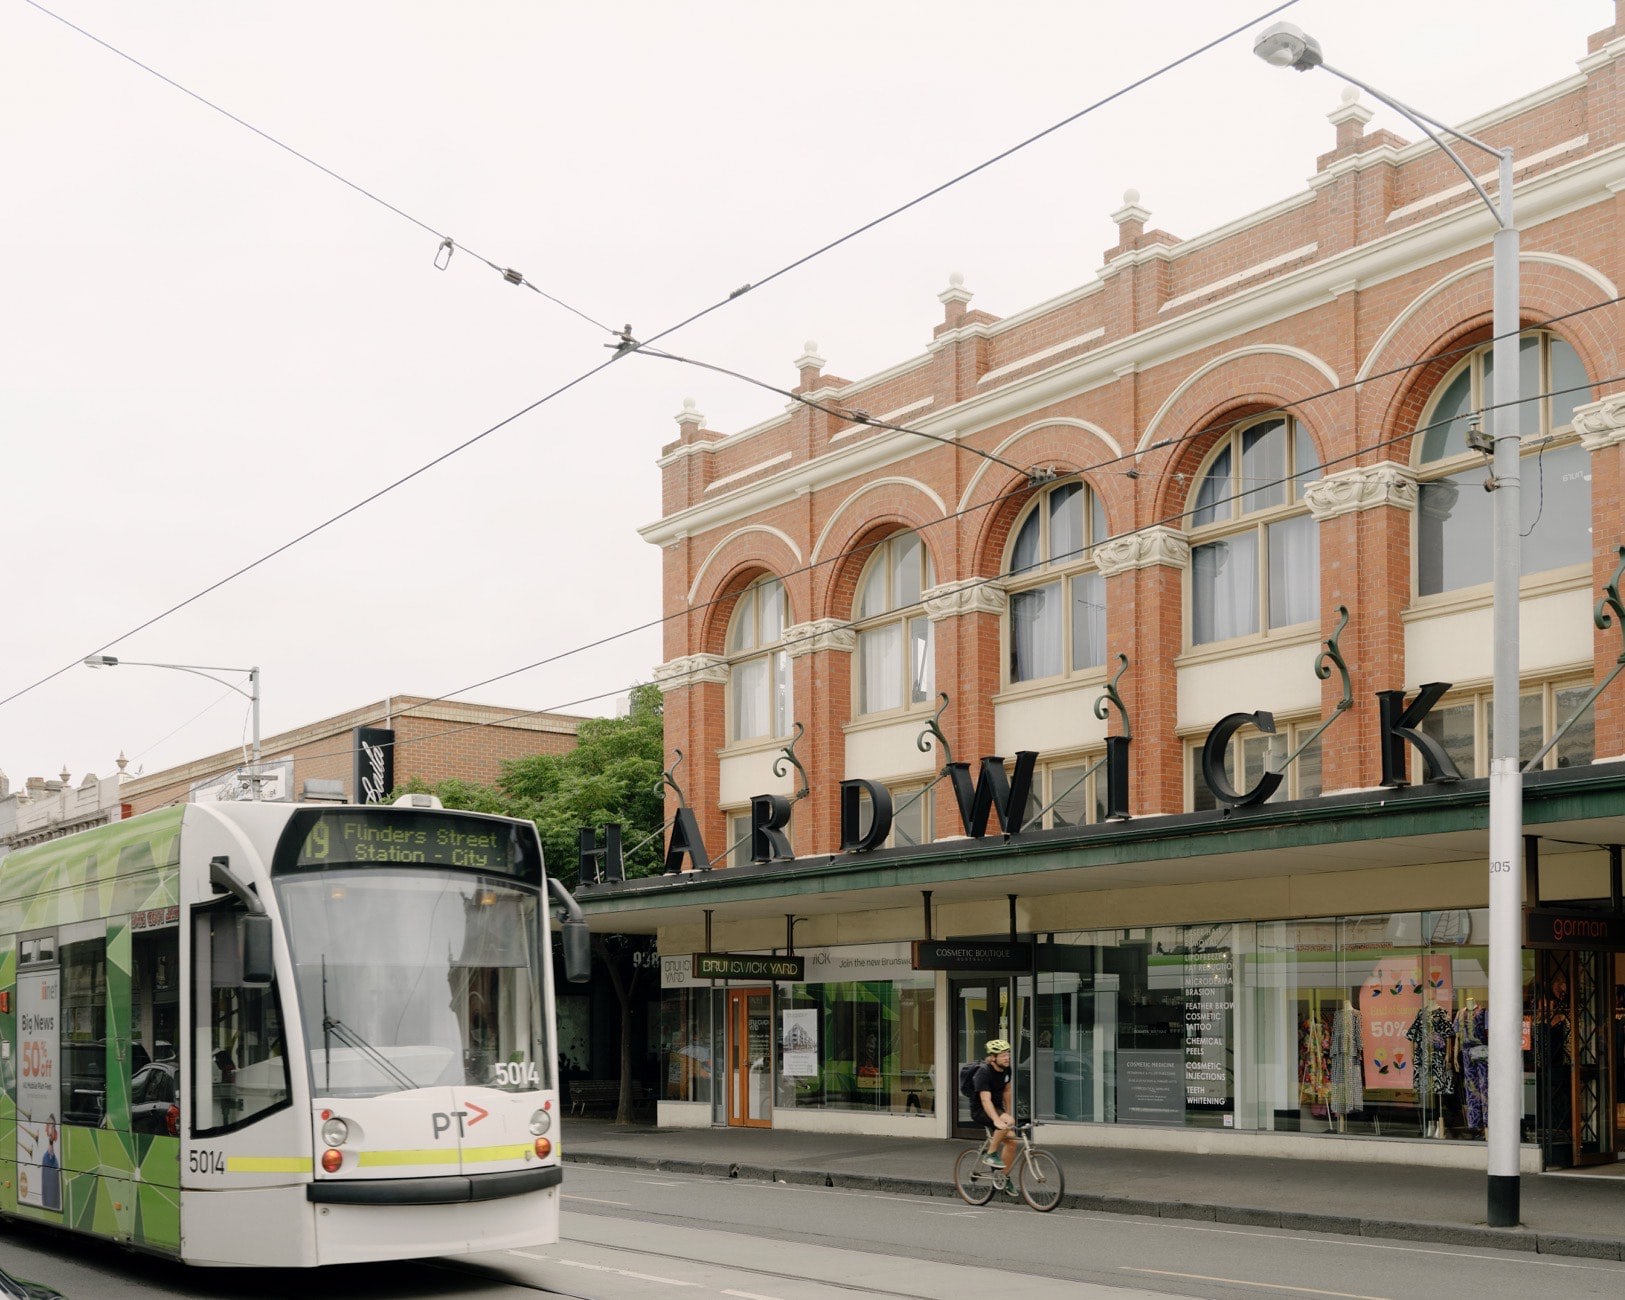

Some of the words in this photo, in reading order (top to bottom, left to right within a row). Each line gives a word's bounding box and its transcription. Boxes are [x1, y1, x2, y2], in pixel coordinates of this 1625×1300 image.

[578, 682, 1462, 886] HARDWICK
[344, 823, 427, 845] Flinders
[436, 829, 498, 848] Street
[355, 844, 425, 863] Station
[452, 849, 488, 866] City
[1490, 861, 1511, 874] 205
[1553, 918, 1608, 941] gorman
[935, 947, 974, 958] COSMETIC
[975, 948, 1011, 959] BOUTIQUE
[702, 959, 768, 975] BRUNSWICK
[769, 963, 798, 976] YARD
[839, 959, 853, 968] Join
[854, 958, 865, 967] the
[866, 959, 880, 967] new
[1185, 988, 1216, 996] BRASION
[1185, 1002, 1214, 1010] FEATHER
[1185, 1012, 1221, 1021] COSMETIC
[21, 1013, 33, 1035] Big
[34, 1013, 54, 1031] News
[1185, 1023, 1212, 1031] TATTOO
[1371, 1021, 1408, 1038] 50%
[1185, 1037, 1223, 1046] CHEMICAL
[1185, 1047, 1205, 1056] PEELS
[40, 1059, 53, 1077] off
[1185, 1061, 1222, 1070] COSMETIC
[495, 1061, 540, 1086] 5014
[1185, 1072, 1226, 1081] INJECTIONS
[1186, 1086, 1205, 1094] TEETH
[1186, 1096, 1226, 1106] WHITENING
[190, 1149, 225, 1175] 5014
